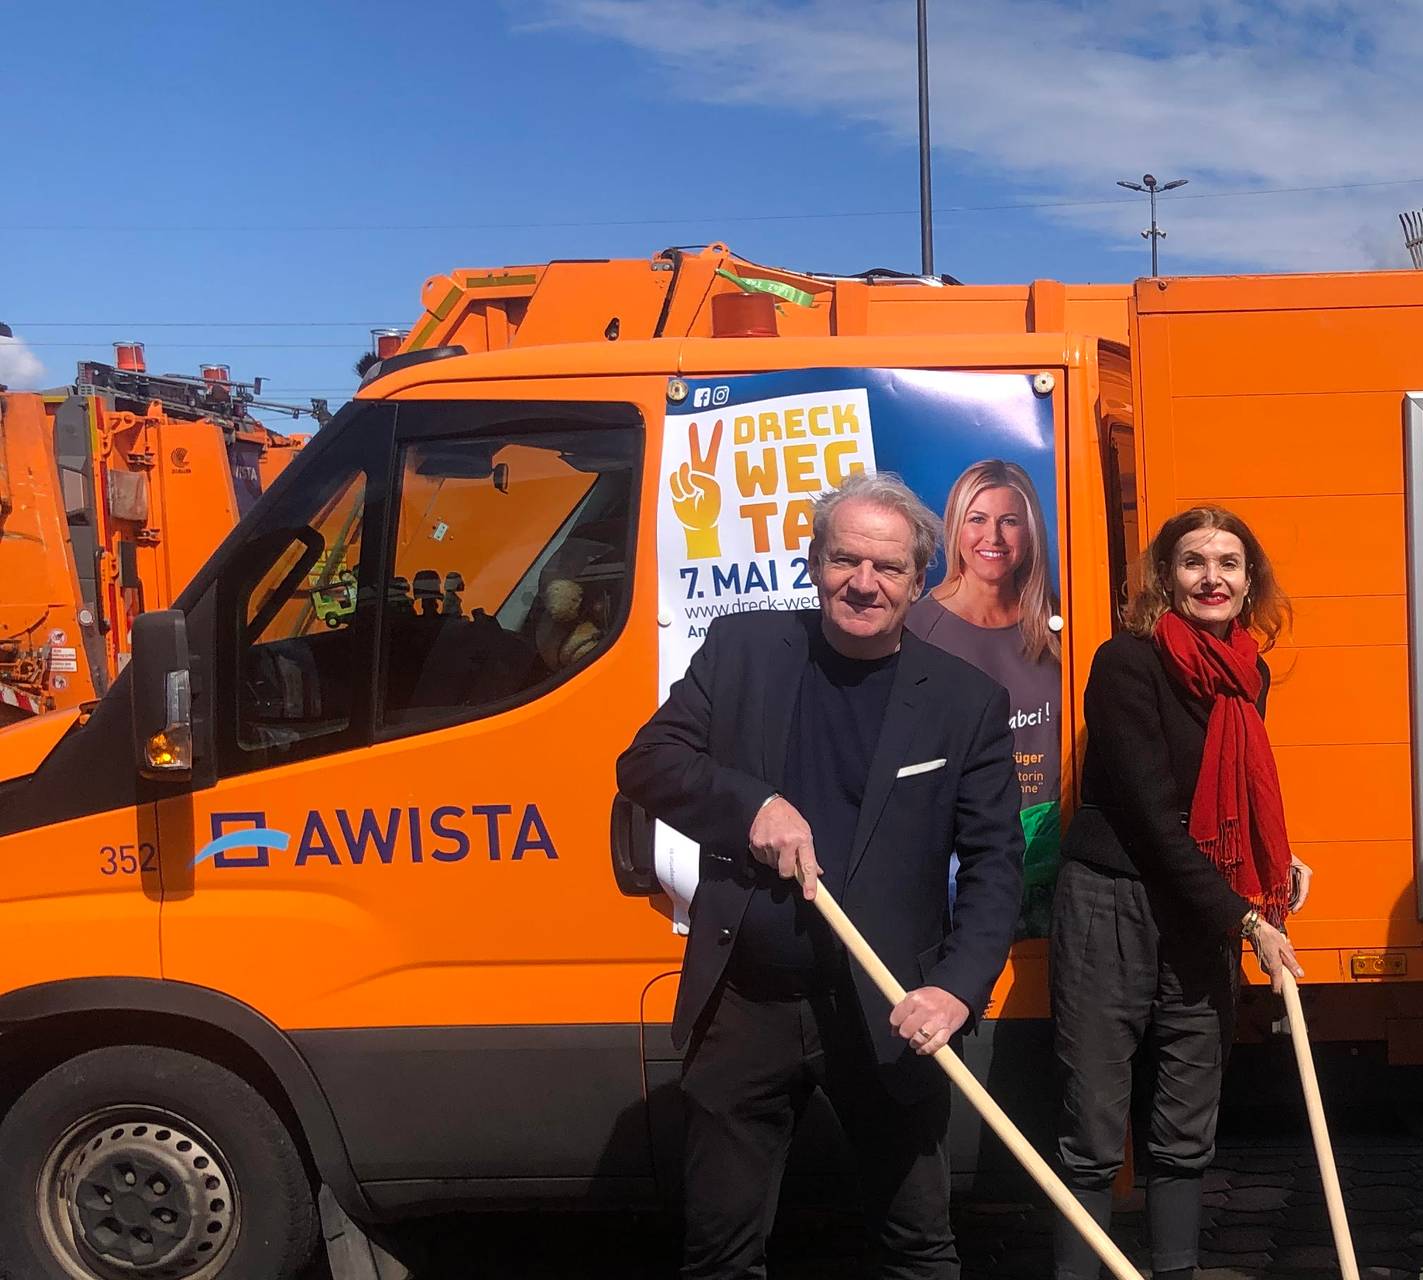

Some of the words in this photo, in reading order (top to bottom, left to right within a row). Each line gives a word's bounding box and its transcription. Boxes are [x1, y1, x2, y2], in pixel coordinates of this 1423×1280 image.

[734, 404, 860, 445] DRECK
[236, 466, 258, 481] ISTA
[734, 440, 864, 498] WEG
[680, 567, 704, 599] 7.
[712, 560, 778, 597] MAI
[688, 625, 708, 639] An
[1013, 752, 1044, 766] üger
[294, 804, 560, 866] AWISTA
[100, 844, 158, 874] 352
